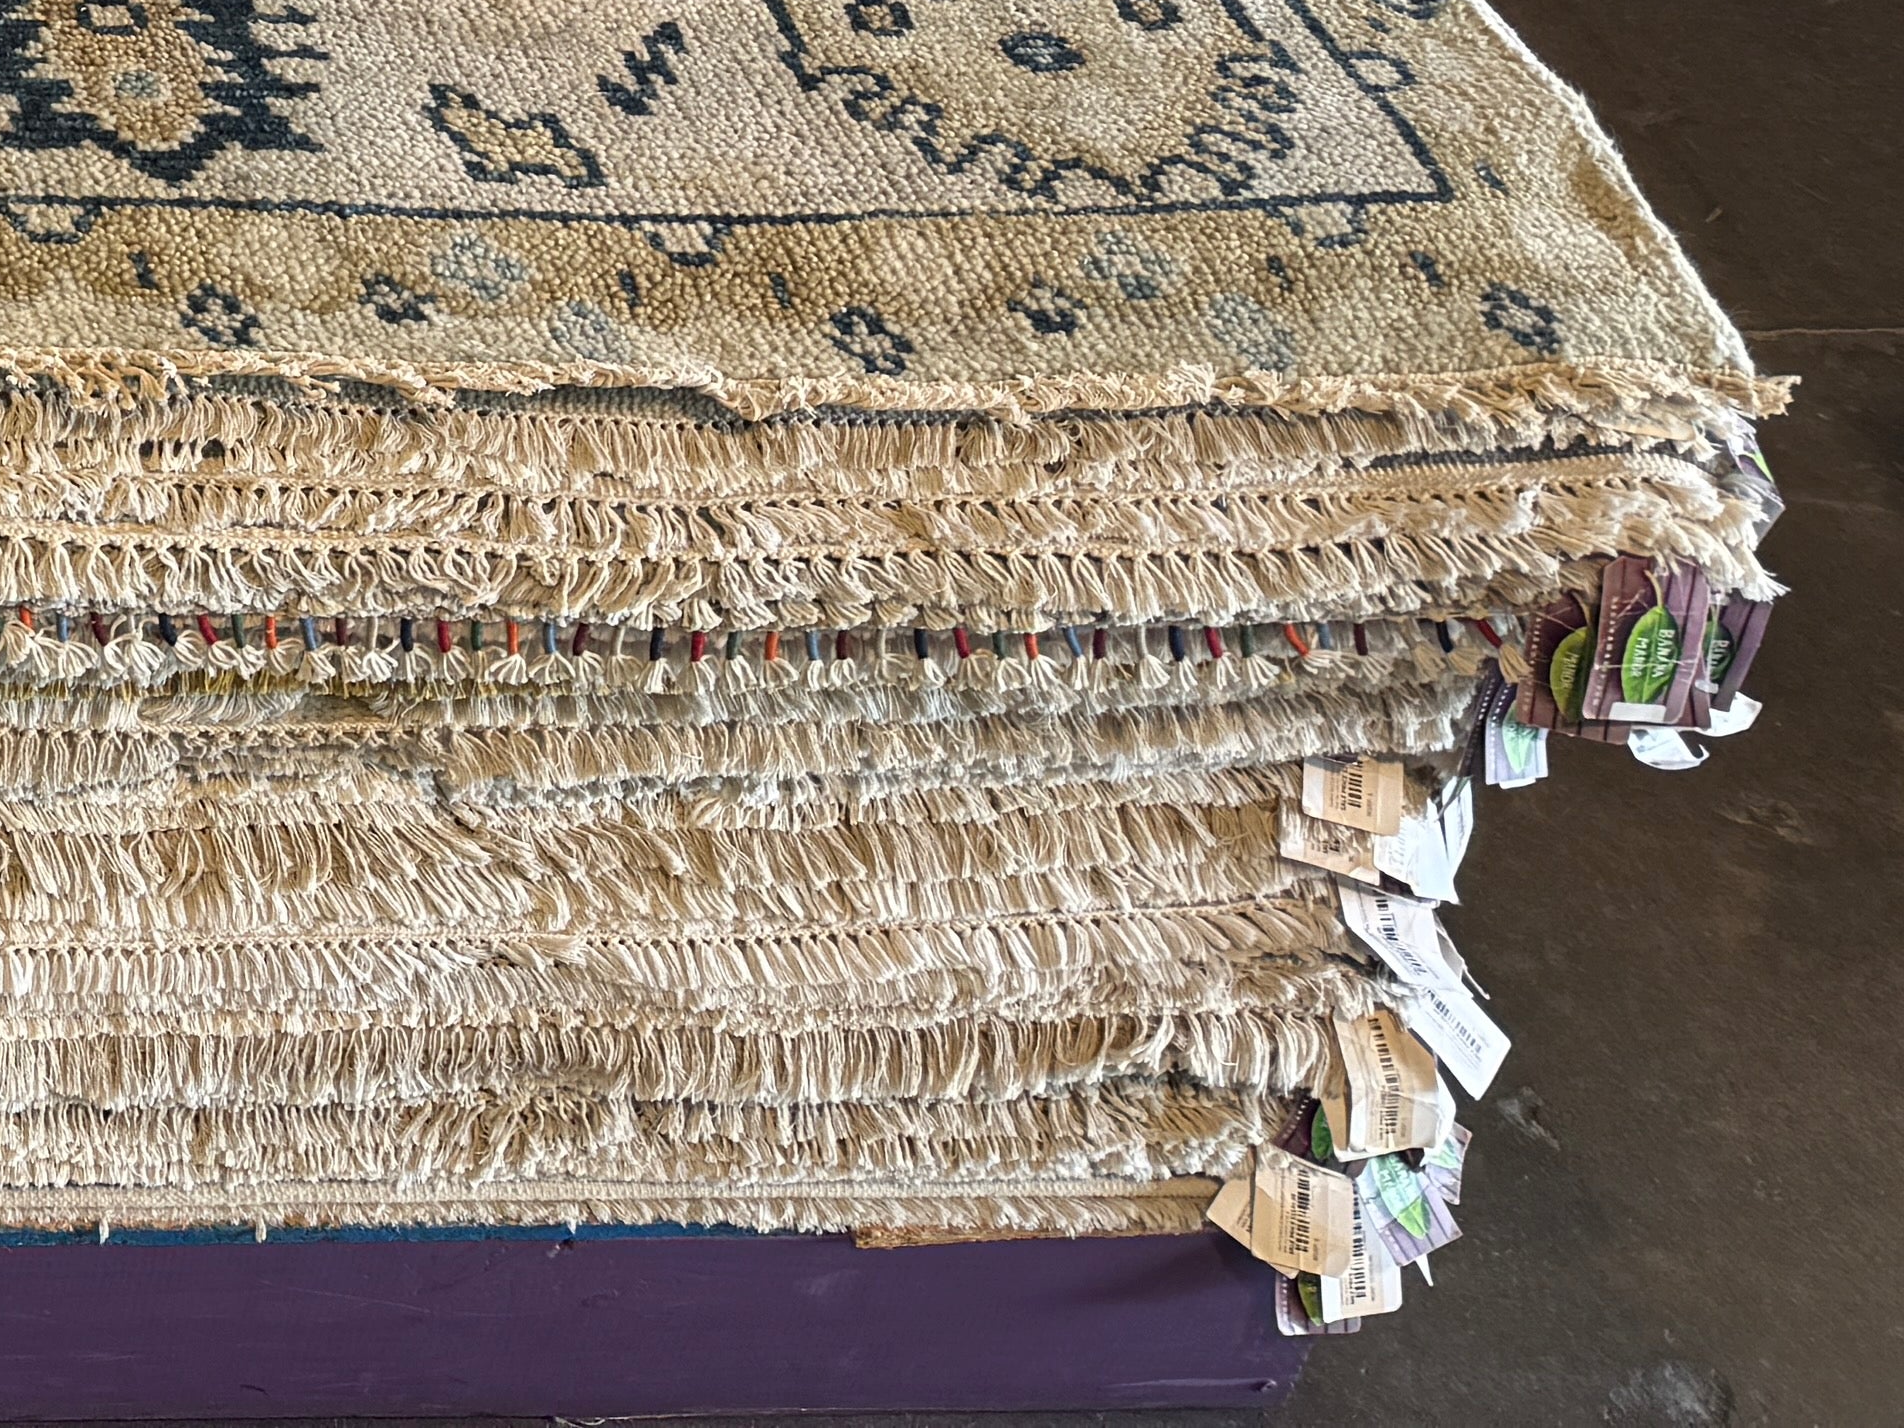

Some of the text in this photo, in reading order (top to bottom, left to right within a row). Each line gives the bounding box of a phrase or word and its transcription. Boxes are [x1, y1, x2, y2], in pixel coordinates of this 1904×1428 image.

[1560, 651, 1580, 690] MANOR
[1631, 636, 1649, 679] MANOR
[1651, 628, 1676, 679] BANANA
